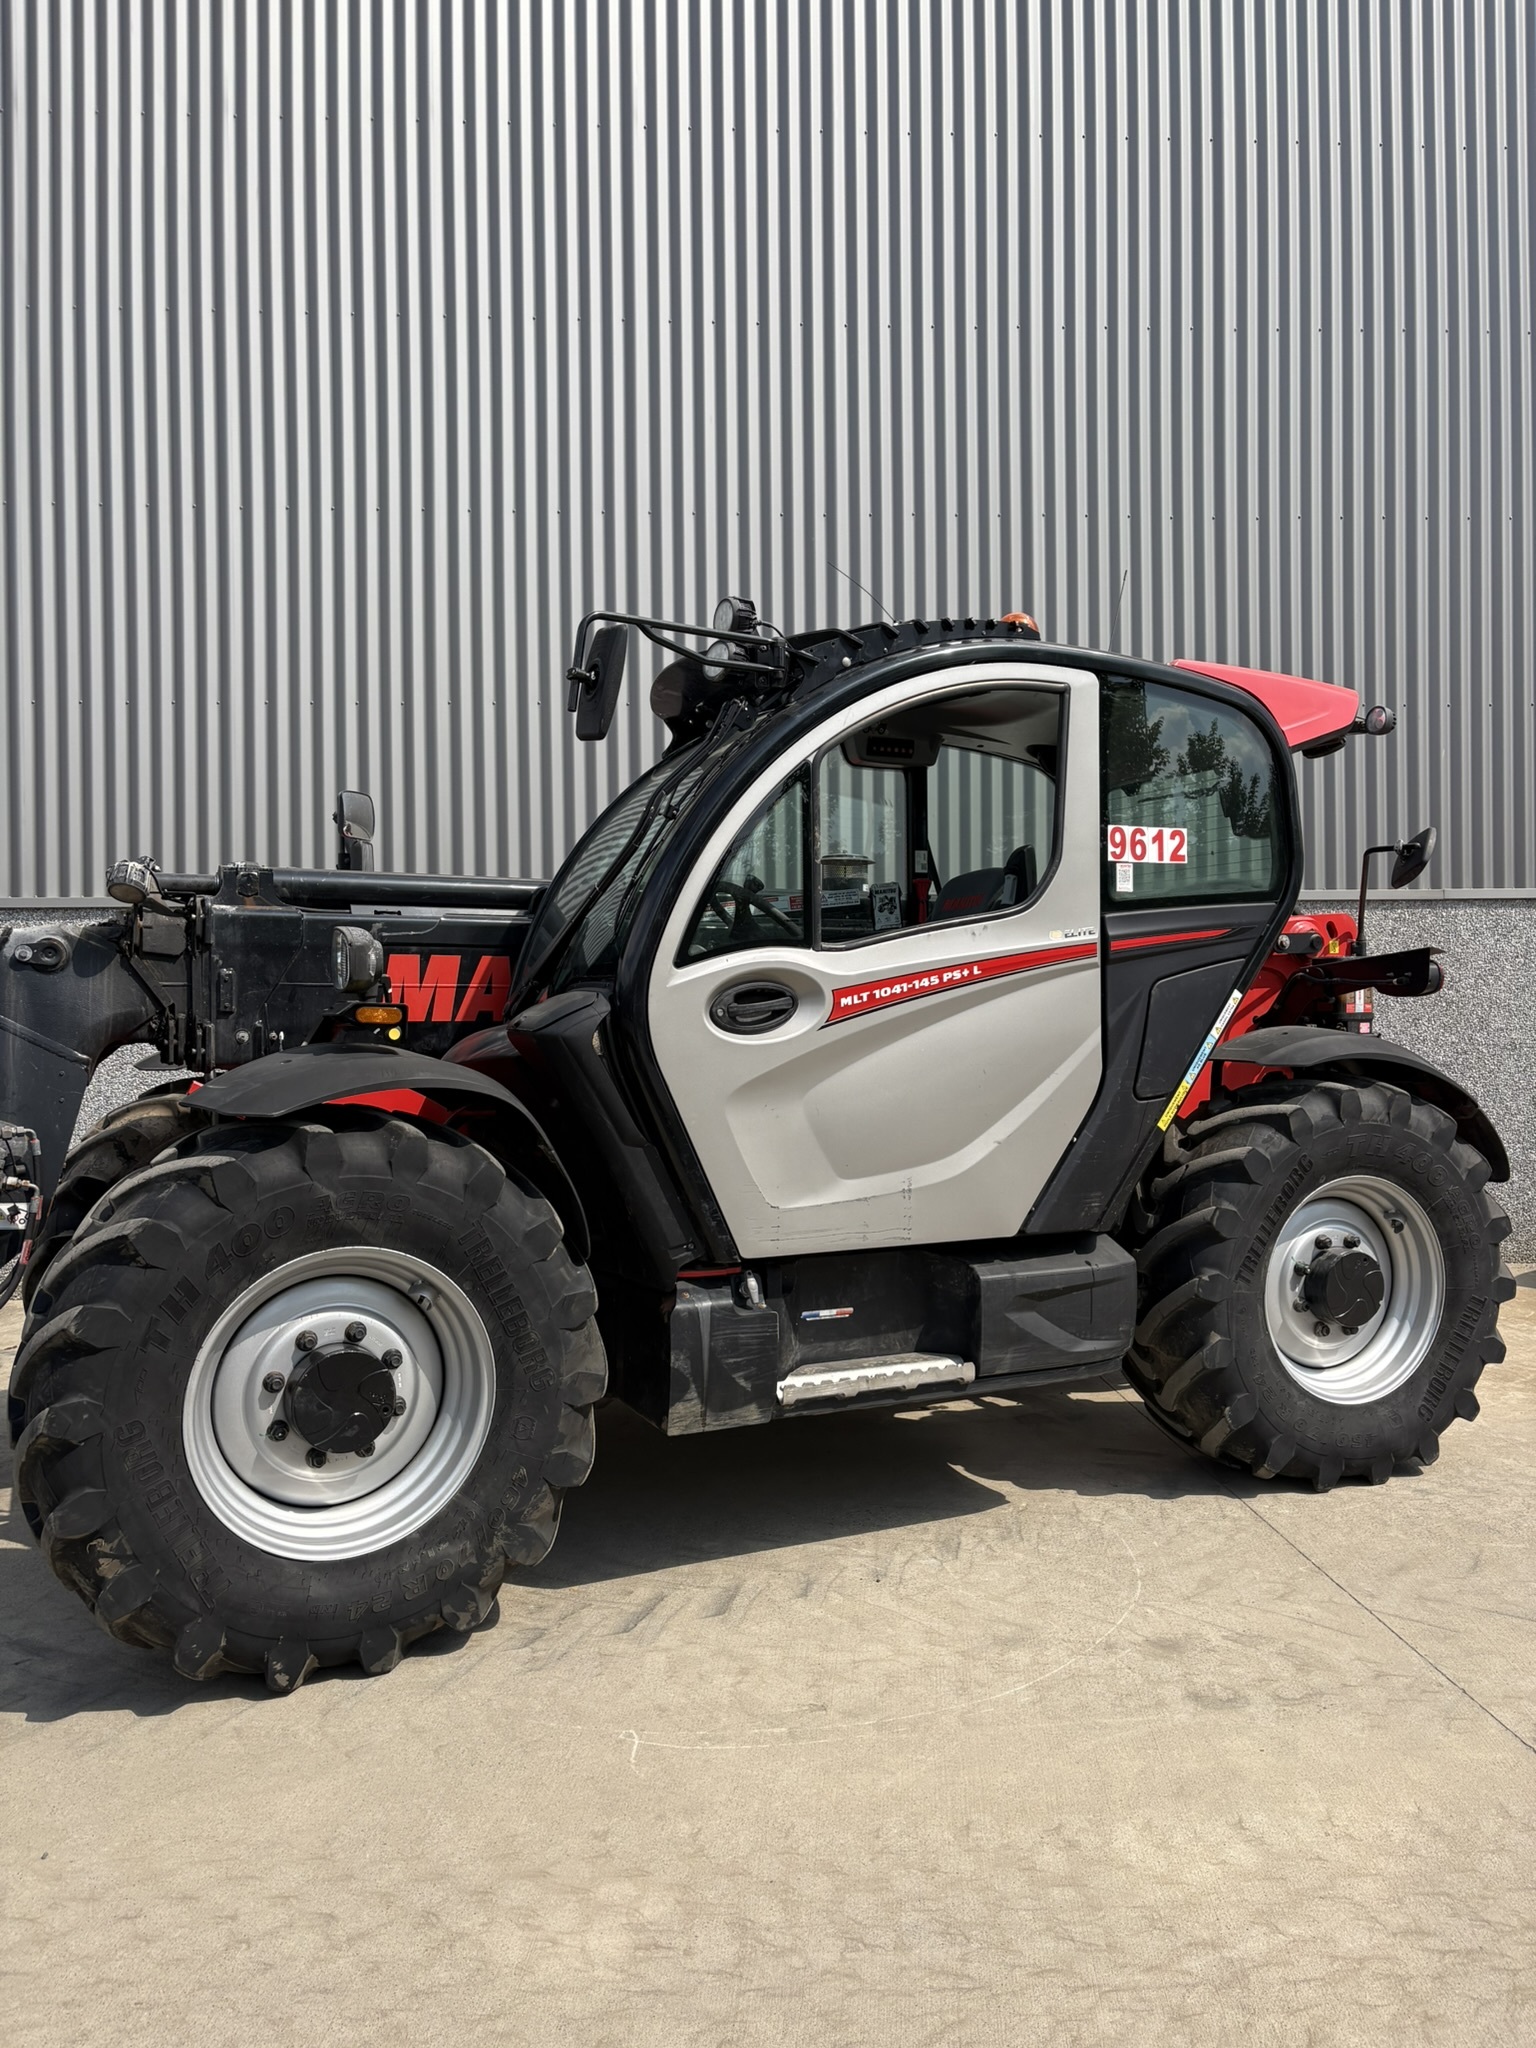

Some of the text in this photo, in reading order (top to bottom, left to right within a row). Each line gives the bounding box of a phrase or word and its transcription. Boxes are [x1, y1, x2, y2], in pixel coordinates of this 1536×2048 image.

[1109, 826, 1186, 862] 9612
[1064, 926, 1096, 939] ELITE
[840, 965, 982, 1007] MLT 1041-145 PS+ L
[1346, 1133, 1449, 1186] TH 400
[1234, 1153, 1314, 1286] TRELLEBORG
[135, 1205, 296, 1354] TH 400
[458, 1219, 557, 1391] TRELLEBORG
[1418, 1294, 1487, 1423] TRELLEBORG
[113, 1420, 232, 1610] TRELLEBORG
[348, 1590, 392, 1624] 24
[402, 1574, 428, 1600] R
